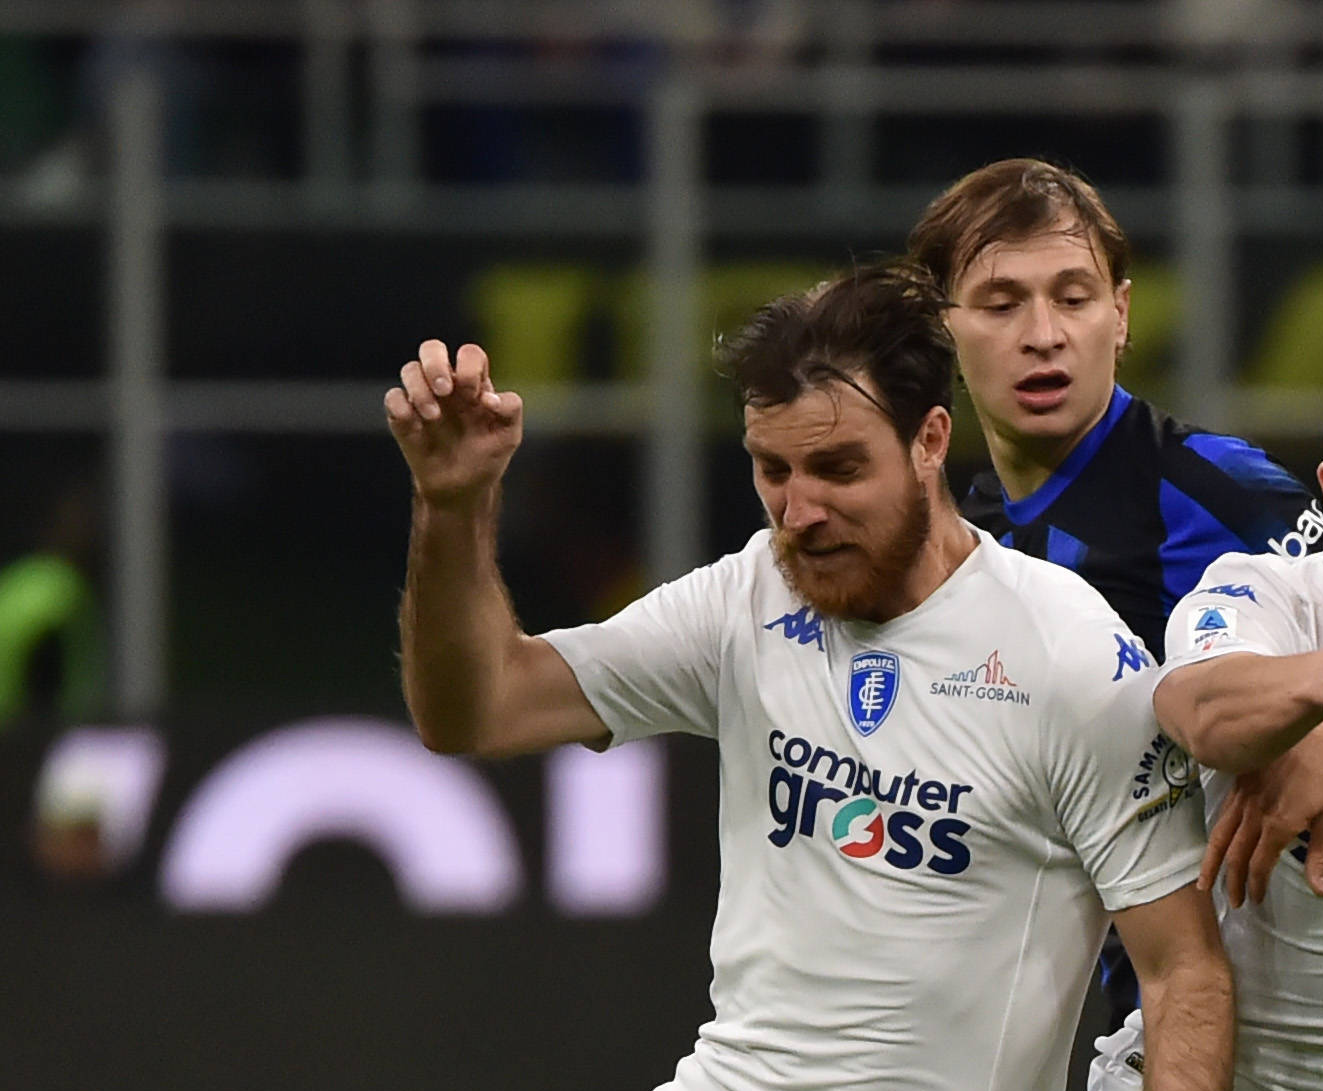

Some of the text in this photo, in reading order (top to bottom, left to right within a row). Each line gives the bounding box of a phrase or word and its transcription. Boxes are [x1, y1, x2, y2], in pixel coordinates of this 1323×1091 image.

[930, 682, 1030, 706] SAINT-GOBAIN
[769, 729, 973, 813] computer
[1132, 733, 1168, 800] SAMM
